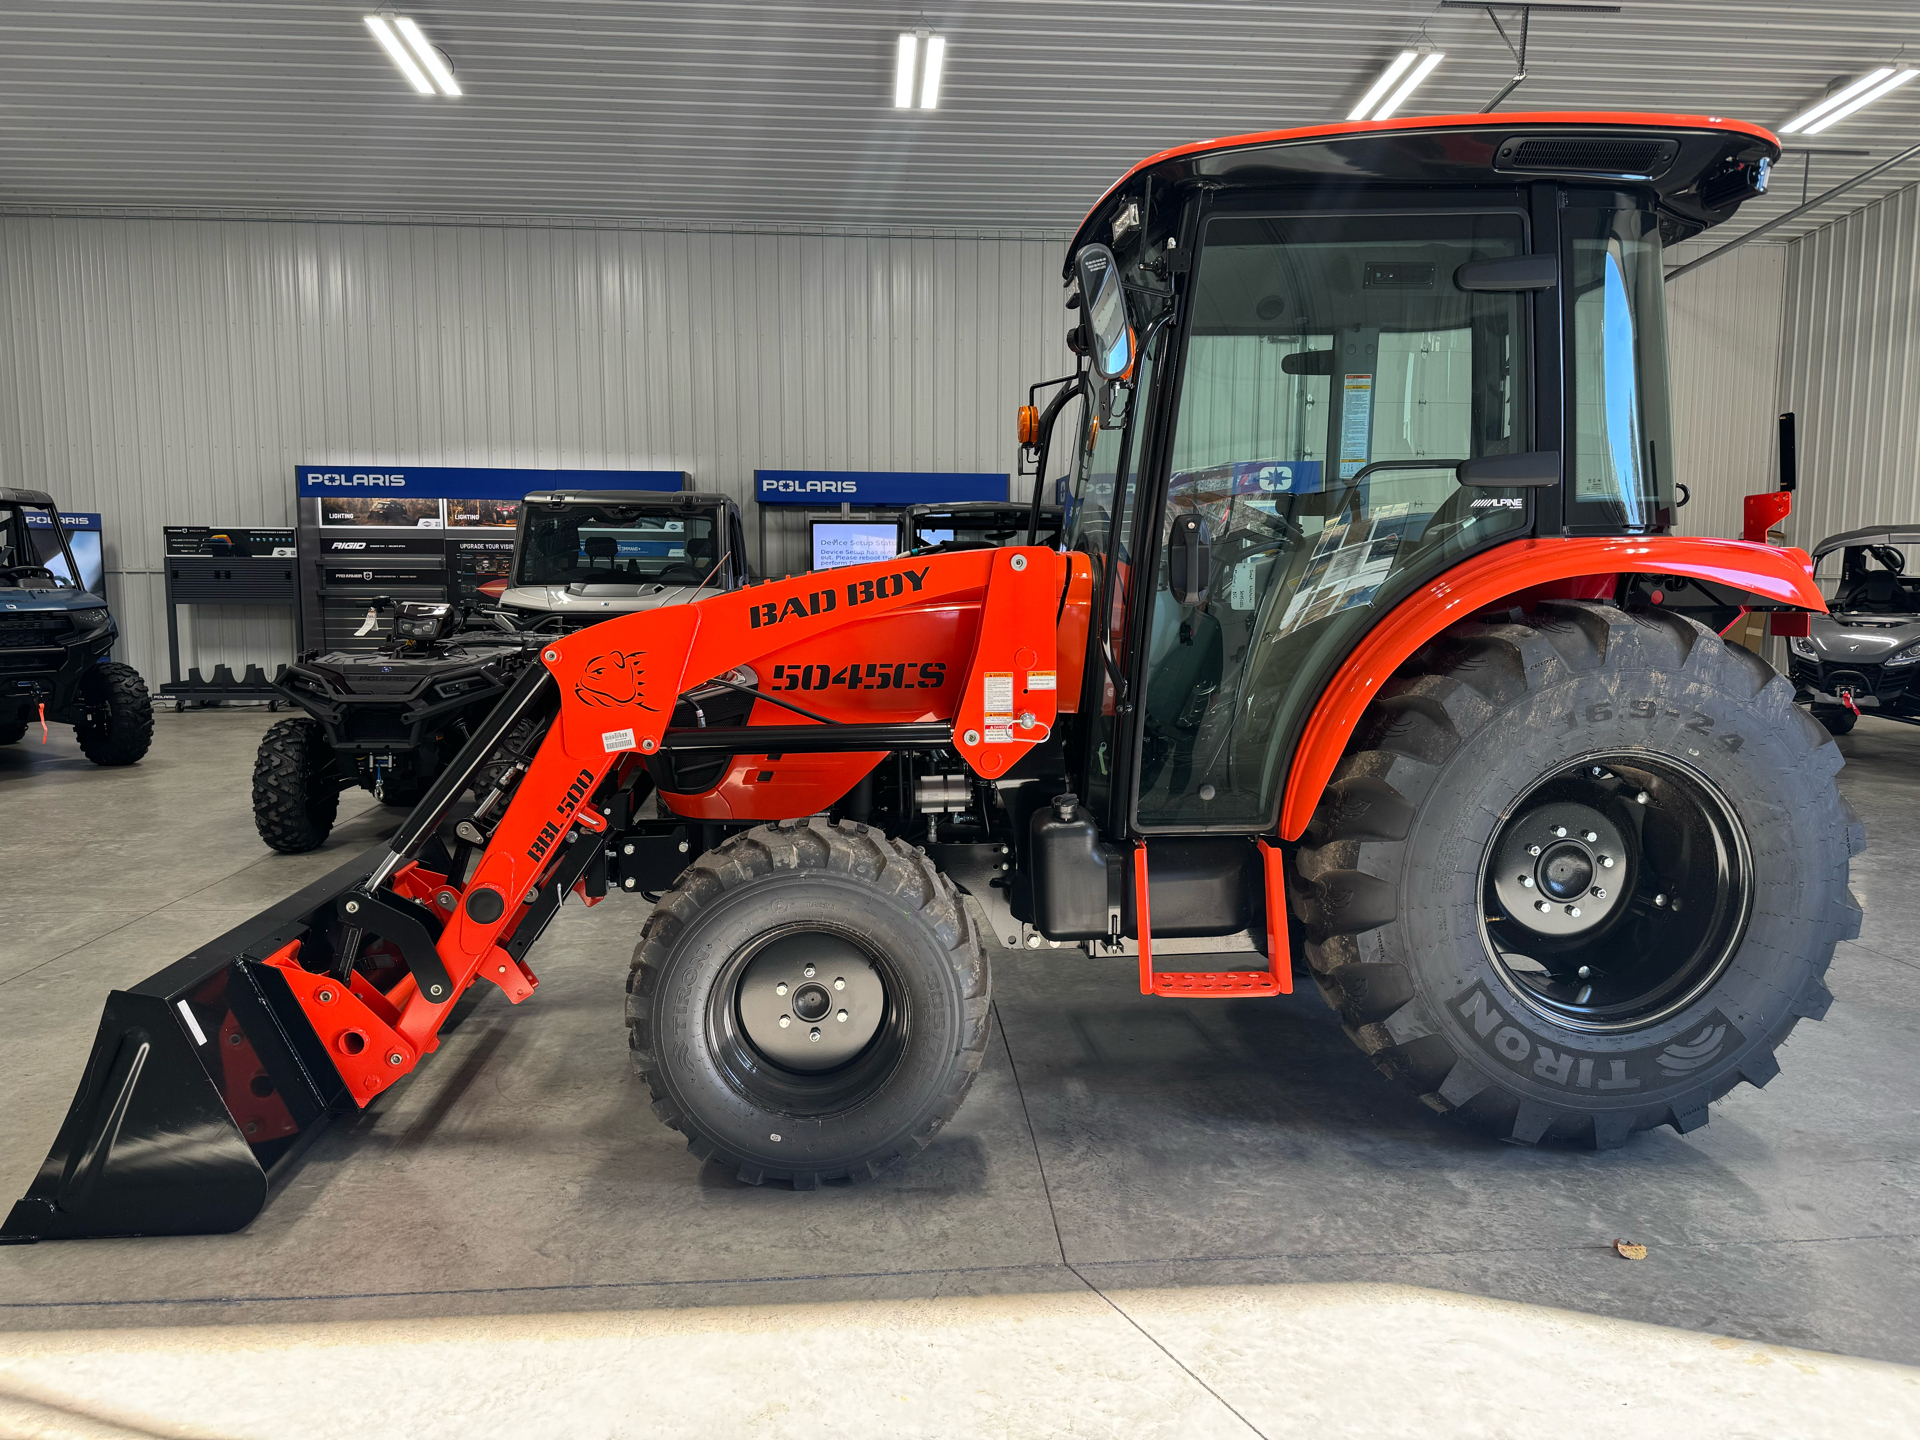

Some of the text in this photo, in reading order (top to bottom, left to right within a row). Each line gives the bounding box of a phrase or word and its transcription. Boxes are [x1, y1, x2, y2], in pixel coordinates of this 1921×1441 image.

[307, 473, 406, 487] POLARIS
[762, 479, 857, 493] POLARIS
[25, 516, 89, 525] POLARIS
[331, 542, 367, 550] RIGID
[850, 539, 874, 547] Setup
[749, 565, 931, 629] BAD BOY
[771, 661, 947, 691] 5045CS
[1560, 699, 1746, 755] 16.9-24
[526, 768, 595, 864] BBL 500
[673, 952, 712, 1037] TIRON
[1457, 988, 1643, 1091] TIRON
